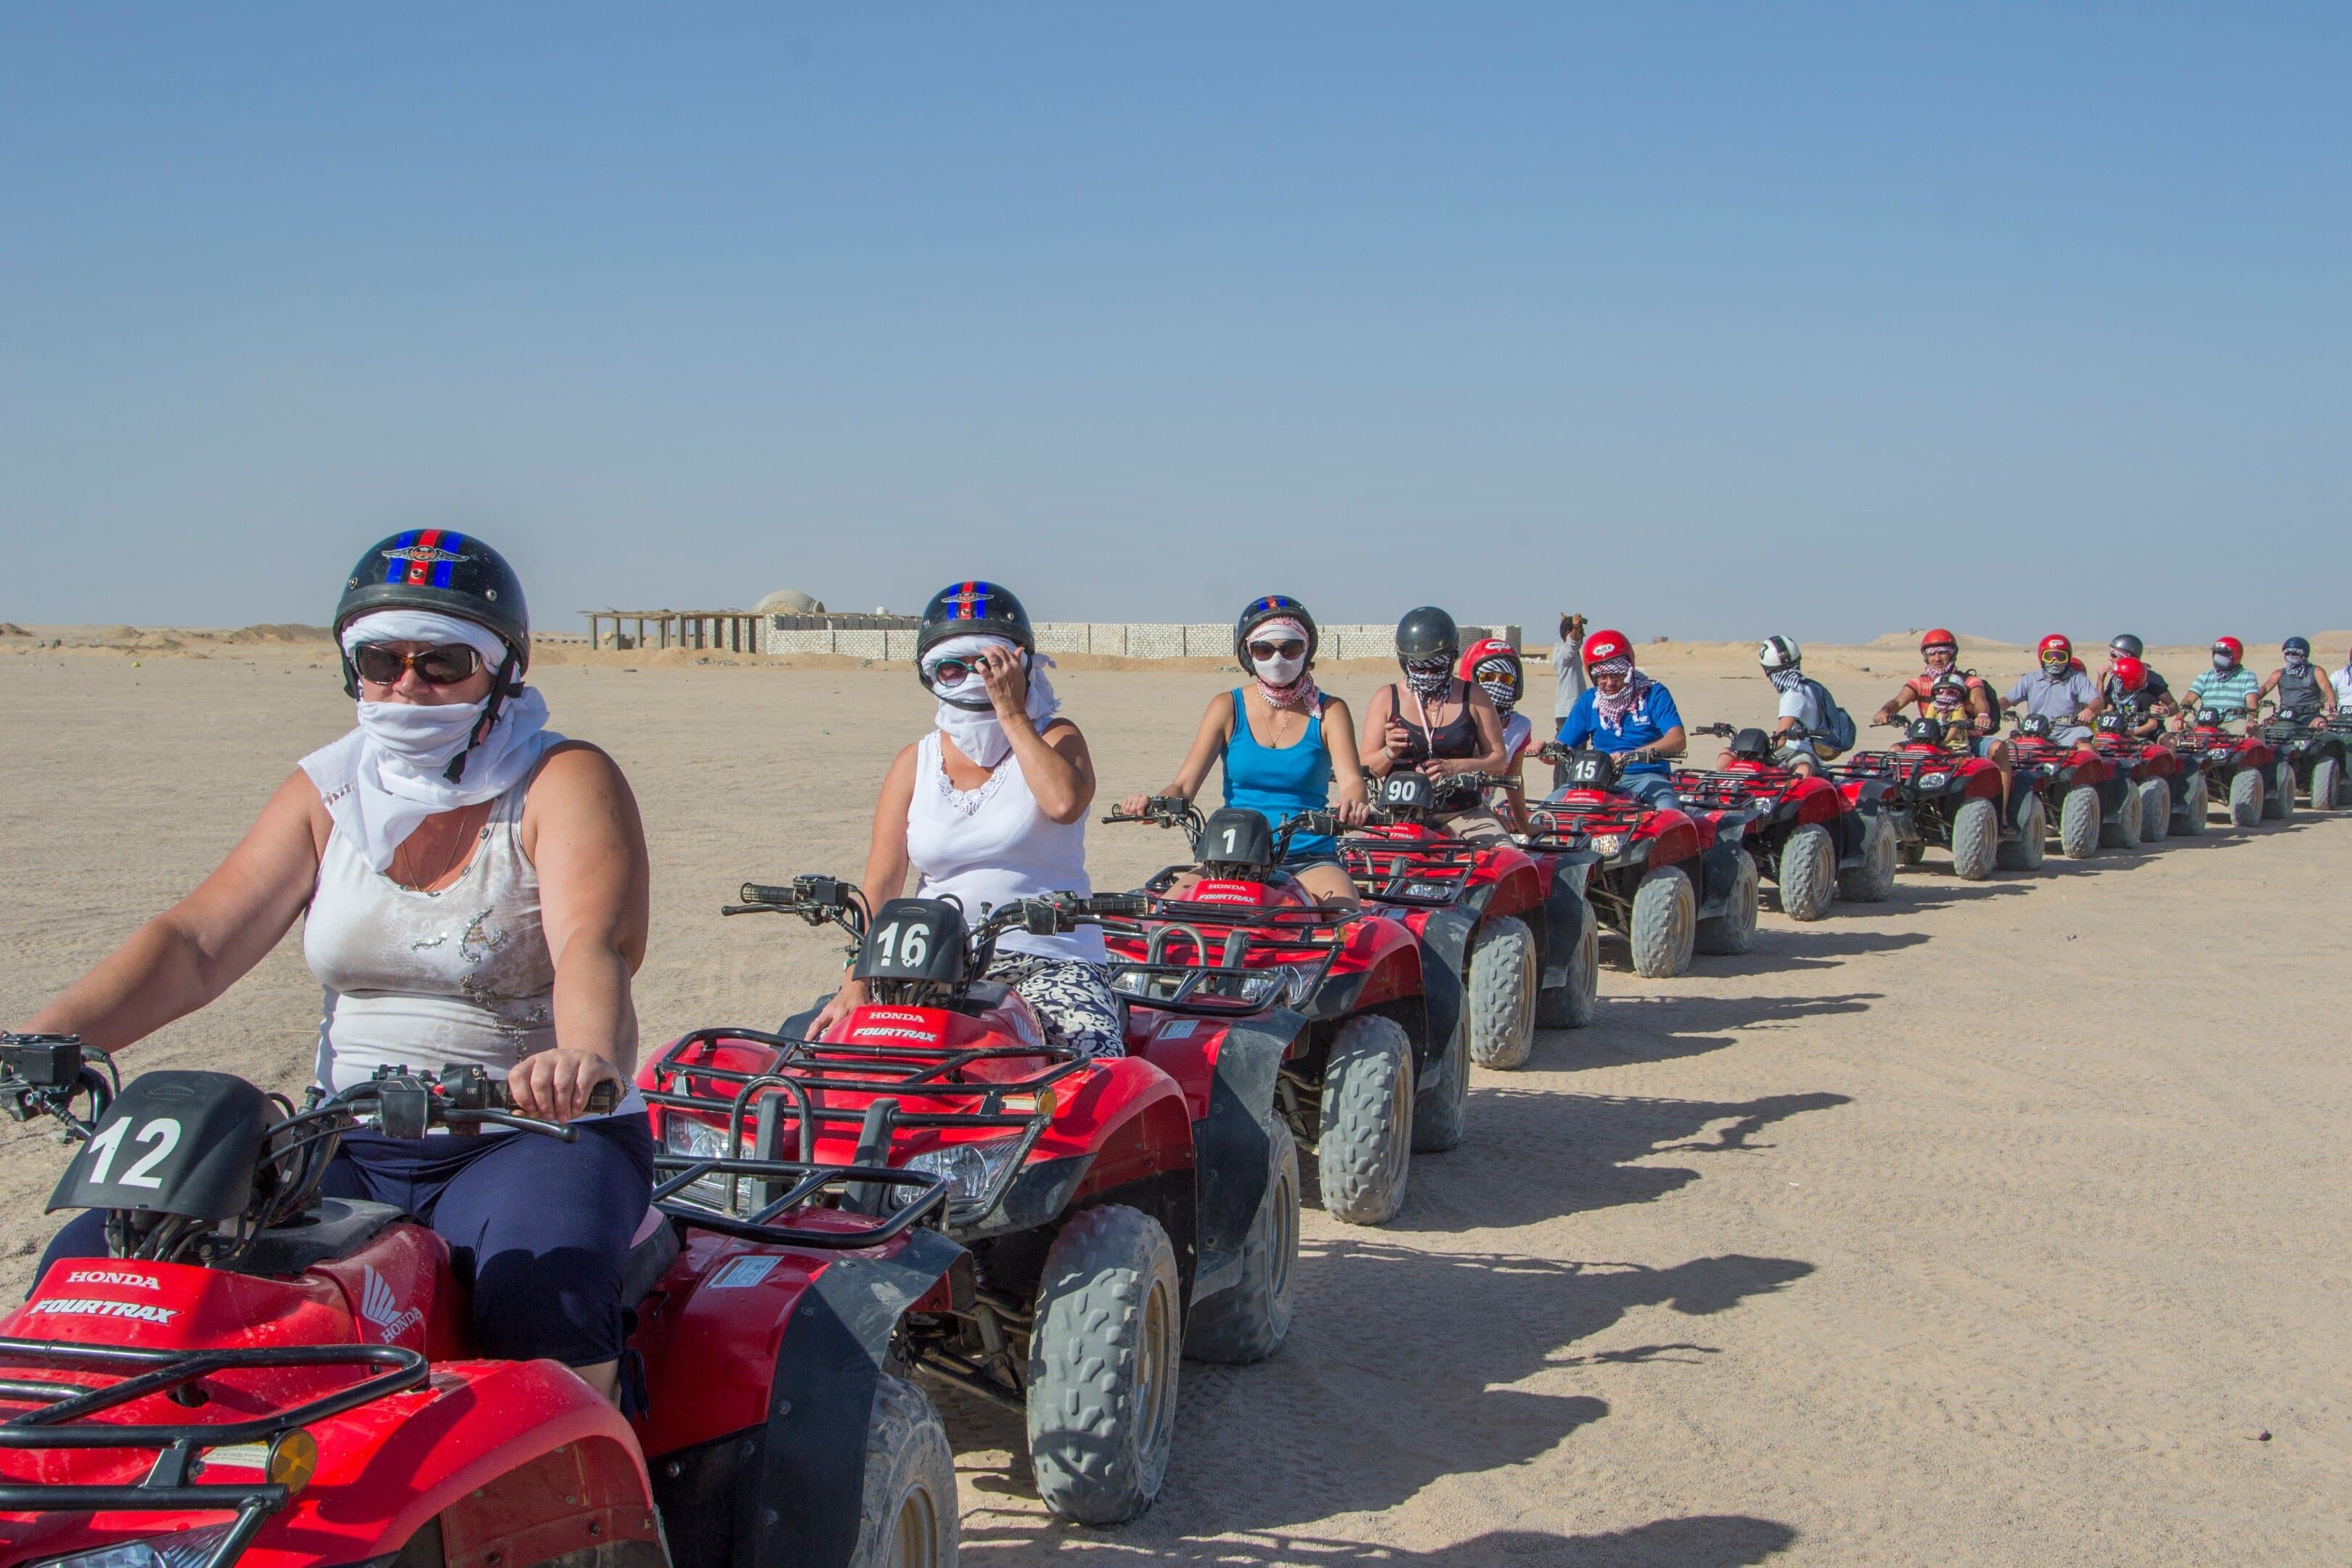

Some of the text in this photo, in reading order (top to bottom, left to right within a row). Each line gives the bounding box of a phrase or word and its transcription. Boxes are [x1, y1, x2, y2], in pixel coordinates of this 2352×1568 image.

[2102, 716, 2118, 727] 97
[2199, 711, 2212, 720] 96
[2280, 710, 2292, 719] 49
[1918, 722, 1926, 733] 2
[2024, 719, 2039, 731] 94
[1575, 760, 1596, 779] 15
[1388, 780, 1416, 801] 90
[1222, 828, 1236, 854] 1
[1197, 894, 1256, 904] FOURTRAX
[877, 922, 930, 968] 16
[869, 1012, 926, 1024] HONDA
[852, 1026, 939, 1043] FOURTRAX
[88, 1116, 181, 1190] 12
[65, 1271, 160, 1291] HONDA
[27, 1299, 179, 1325] FOURTRAX
[380, 1307, 425, 1344] HONDA
